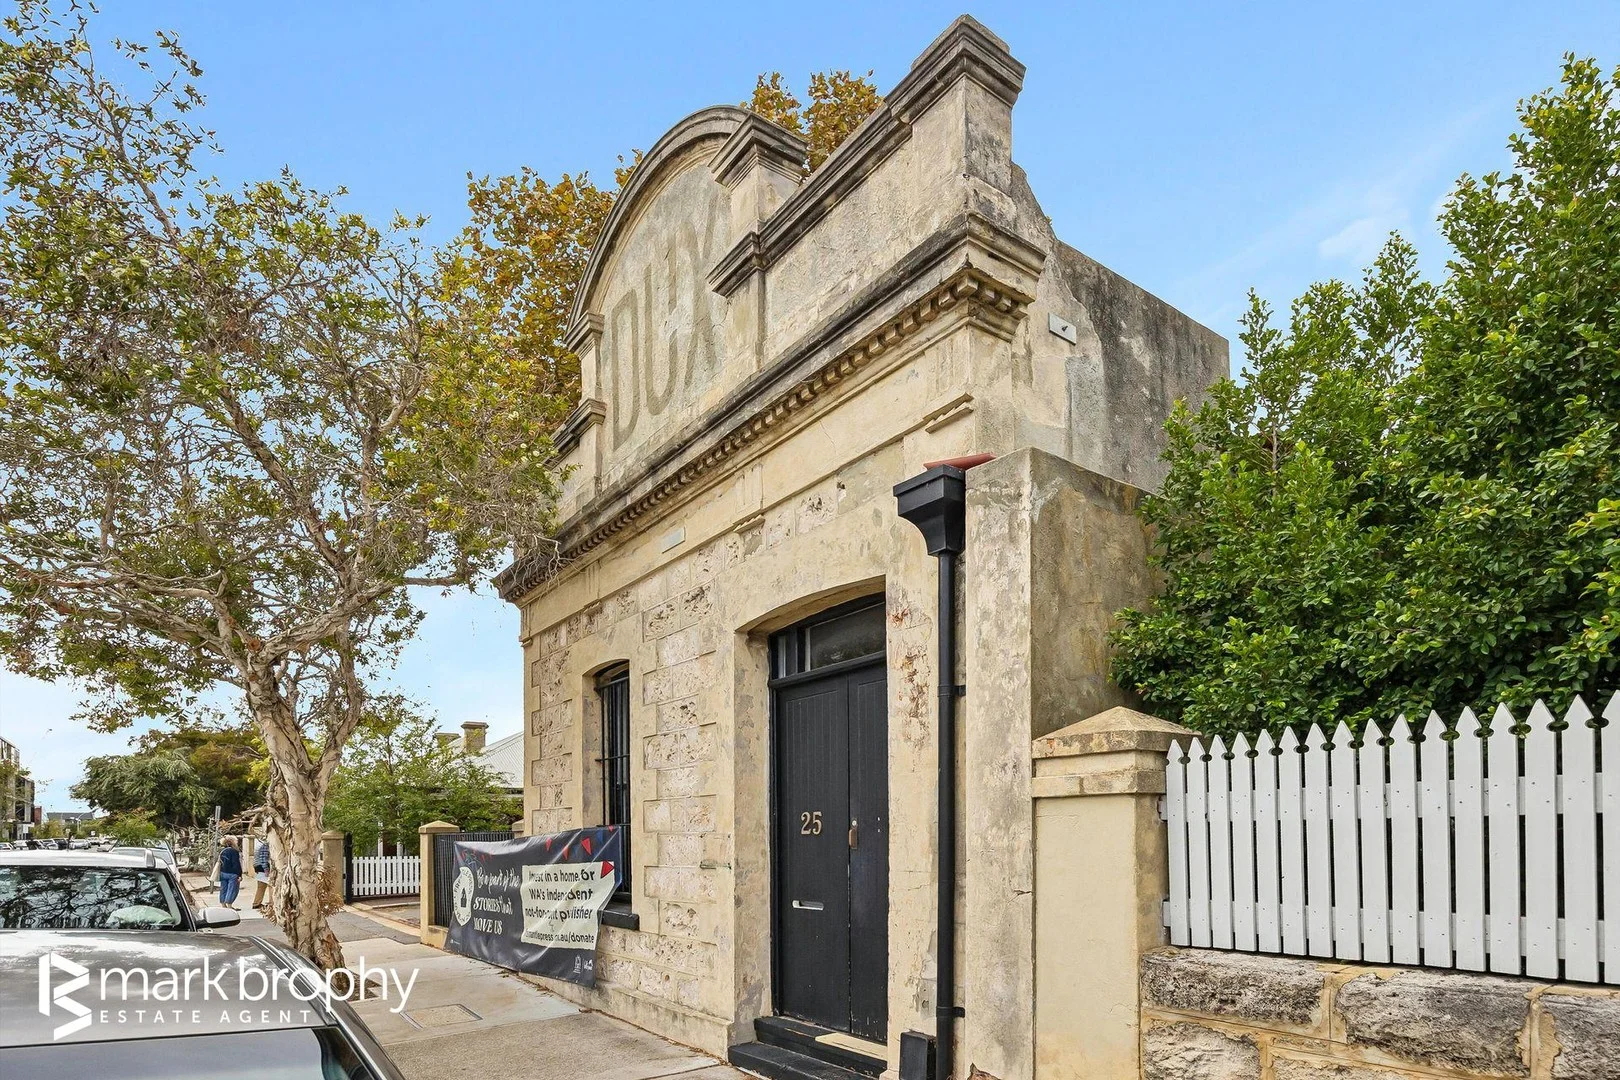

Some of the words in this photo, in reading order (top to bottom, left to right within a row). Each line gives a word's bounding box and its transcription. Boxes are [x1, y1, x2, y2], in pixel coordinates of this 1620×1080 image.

[800, 811, 823, 835] 25
[528, 870, 544, 882] Iest
[544, 870, 551, 882] in
[553, 872, 559, 882] a
[559, 869, 579, 882] home
[528, 888, 546, 901] WA's
[546, 888, 594, 901] indedent
[473, 896, 500, 914] STORIES
[559, 905, 593, 922] plisher
[473, 917, 493, 933] MOVE
[494, 919, 503, 935] US
